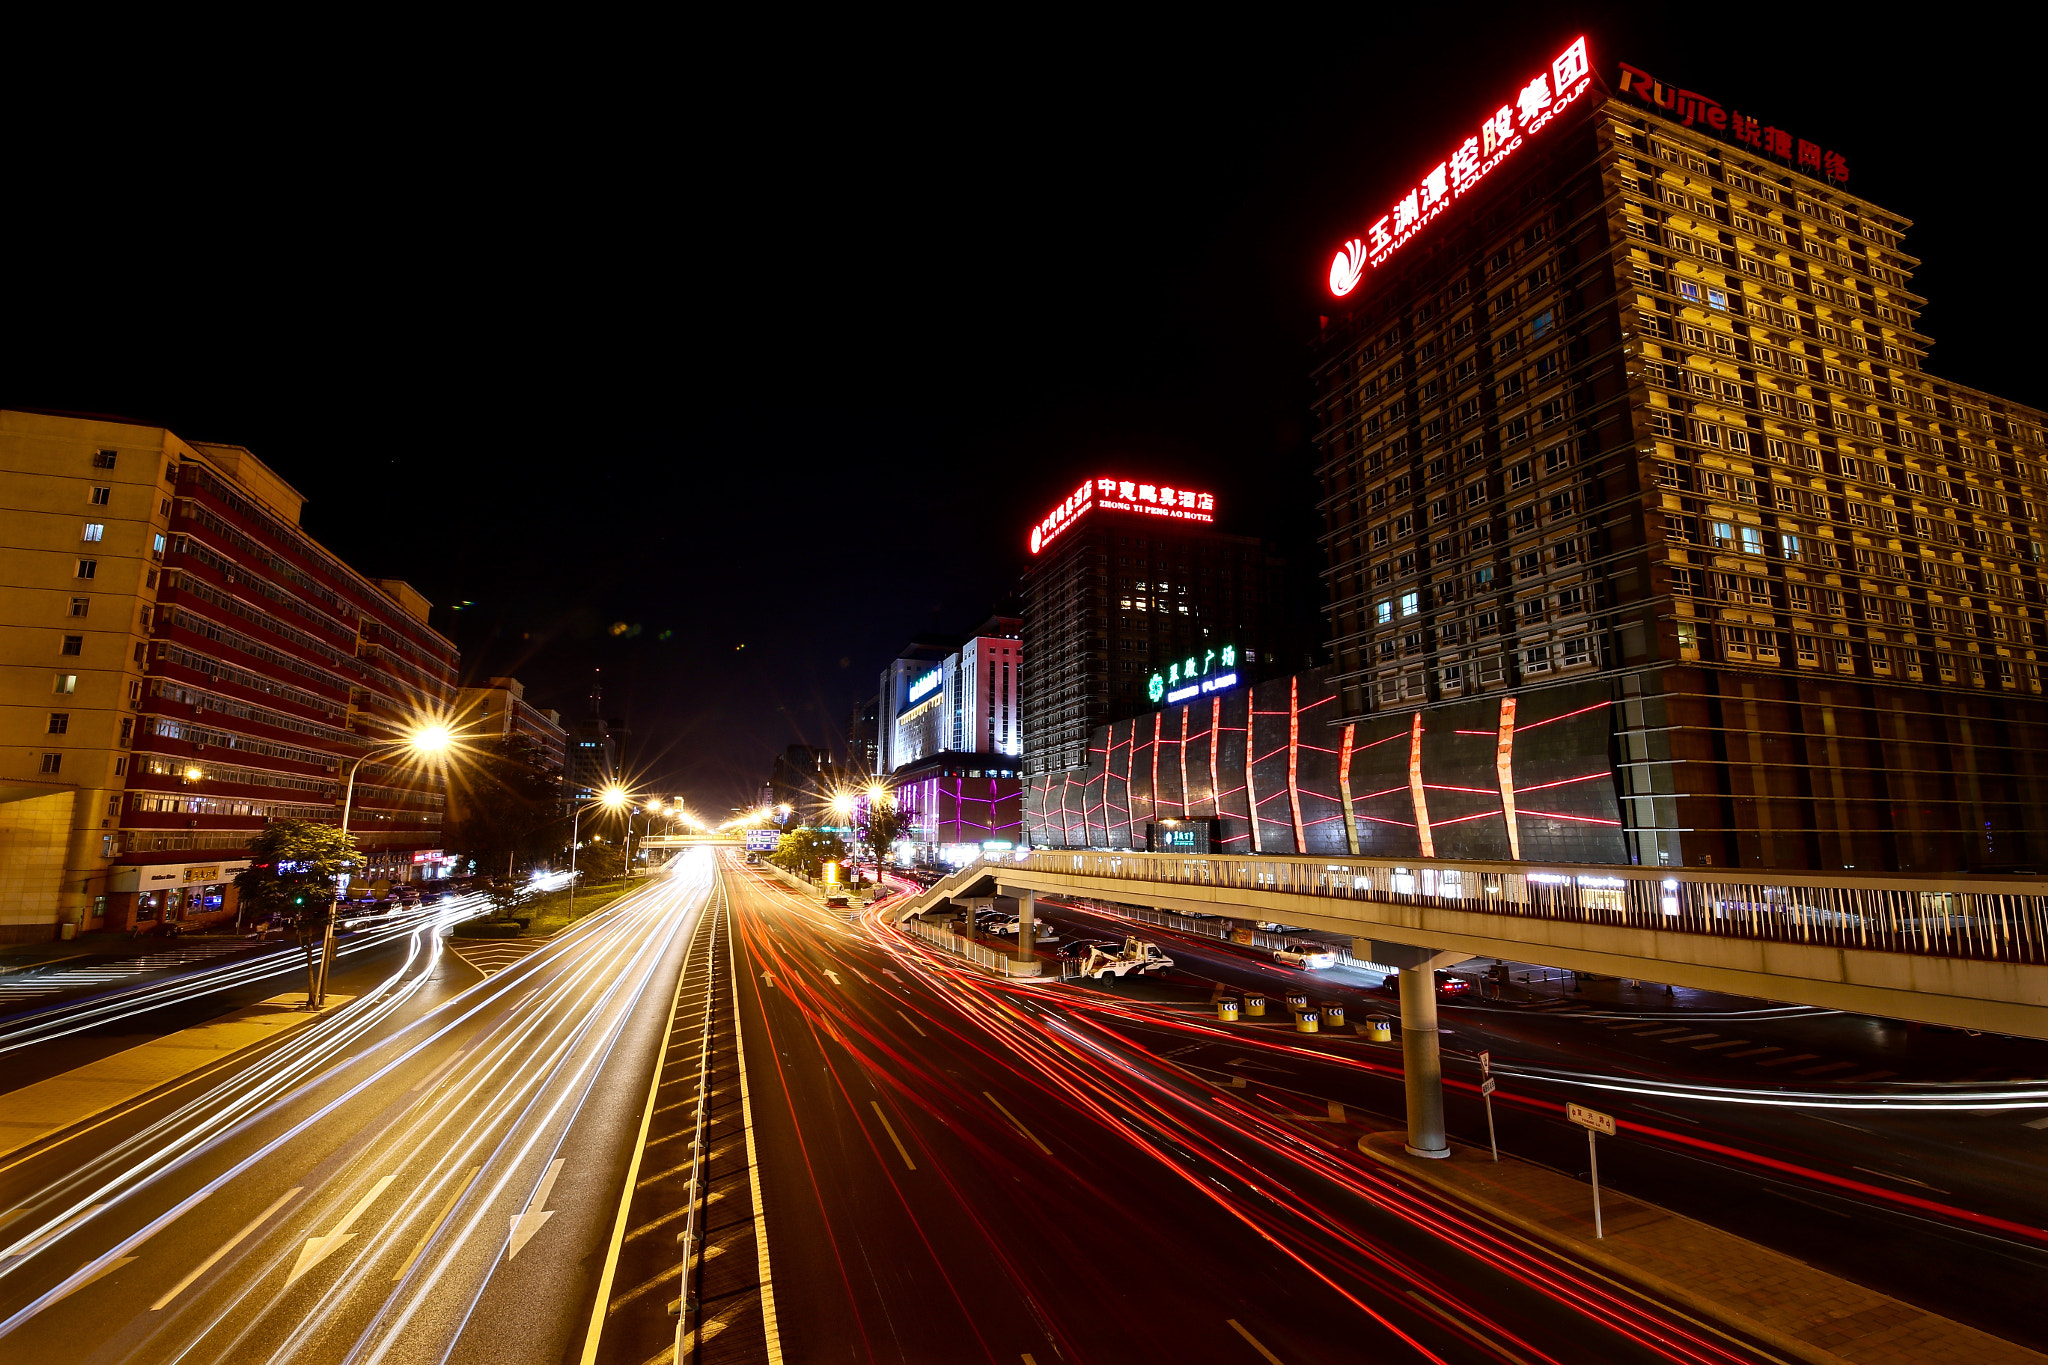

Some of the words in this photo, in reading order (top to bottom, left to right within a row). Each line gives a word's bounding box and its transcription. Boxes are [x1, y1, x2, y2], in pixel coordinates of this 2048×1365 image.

[1618, 61, 1728, 131] Ruijie
[1369, 36, 1589, 257] 玉渊潭控股集团
[1370, 197, 1450, 268] YUYUANTAN
[1454, 135, 1523, 198] HOLDING
[1528, 77, 1591, 134] GROUP
[1731, 110, 1850, 182] 锐捷网络
[1099, 500, 1131, 510] ZHONG
[1133, 504, 1143, 513] YI
[1145, 506, 1169, 516] PENG
[1170, 510, 1183, 518] AO
[1184, 512, 1214, 522] HOTEL
